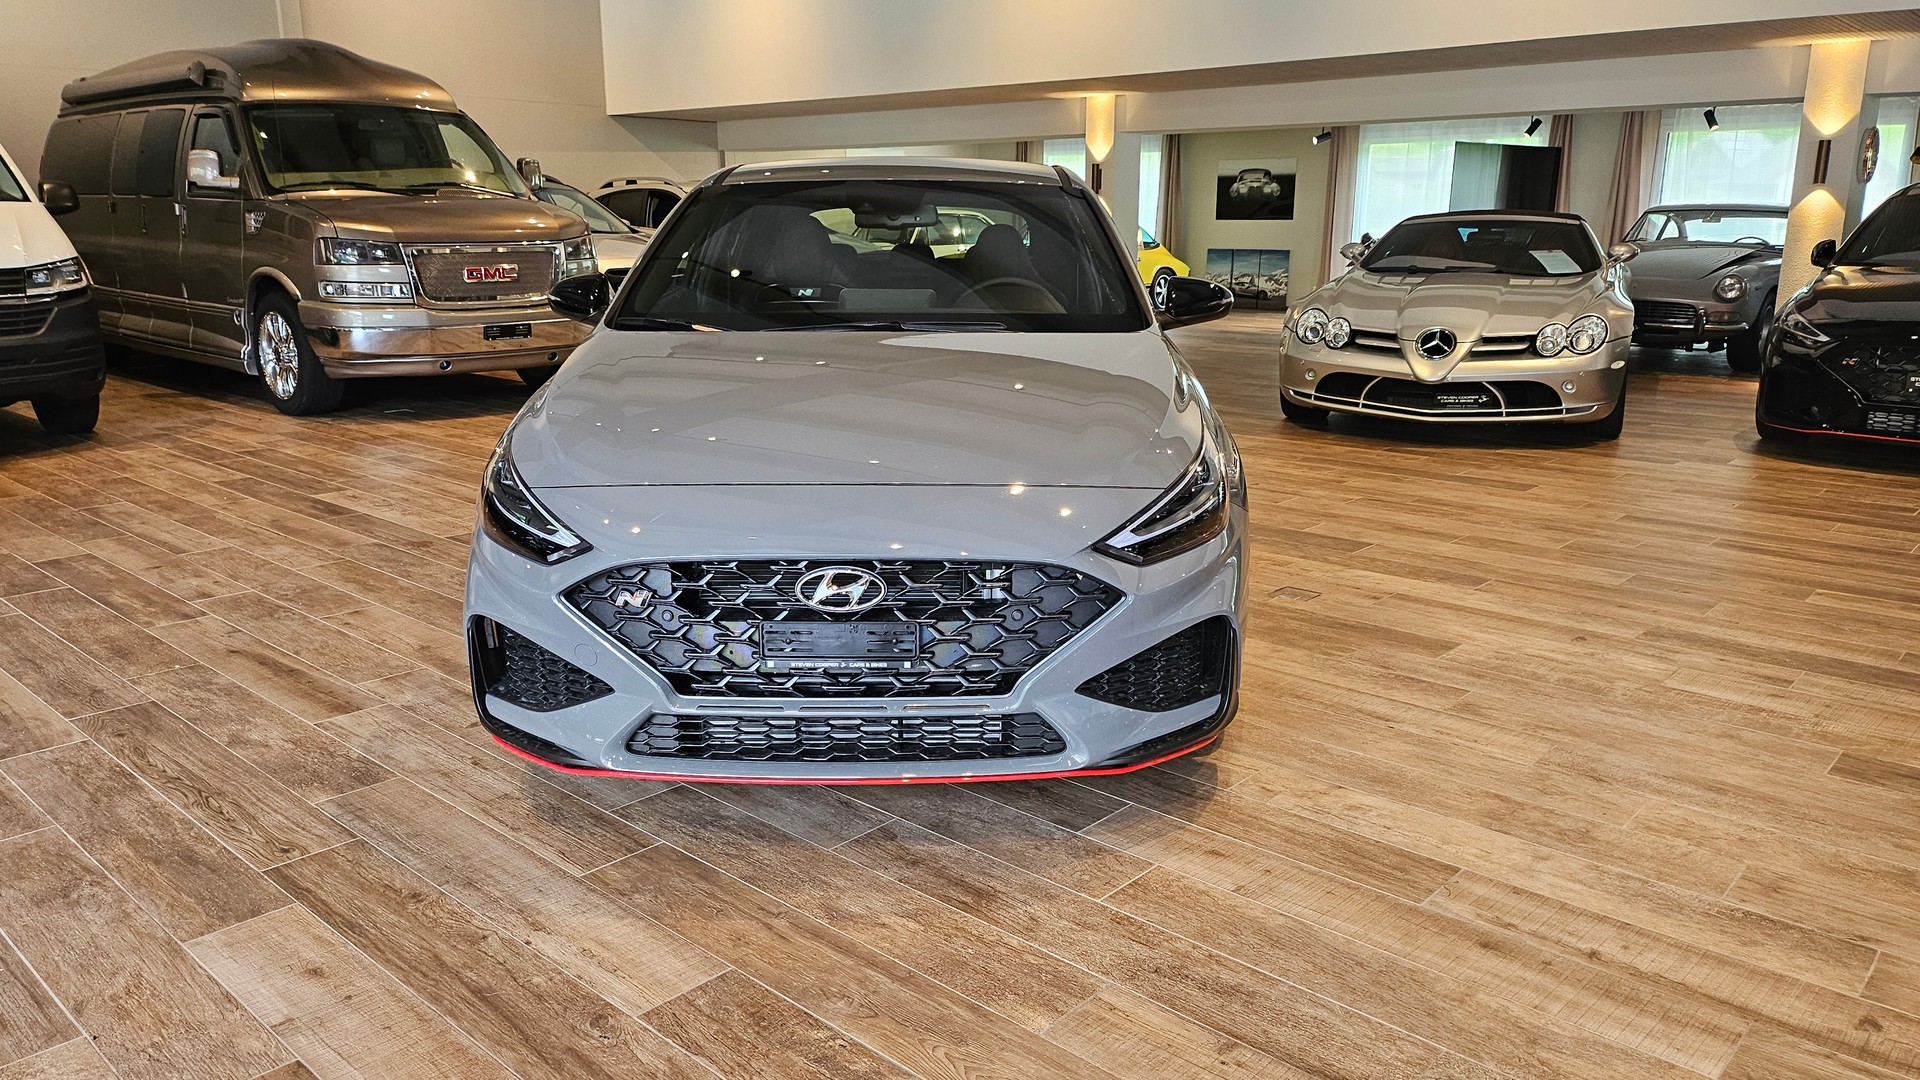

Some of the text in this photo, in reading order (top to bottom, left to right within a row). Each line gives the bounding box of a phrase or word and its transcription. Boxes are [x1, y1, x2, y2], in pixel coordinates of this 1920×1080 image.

[464, 264, 518, 282] GMC
[797, 288, 814, 297] N
[614, 589, 653, 609] N
